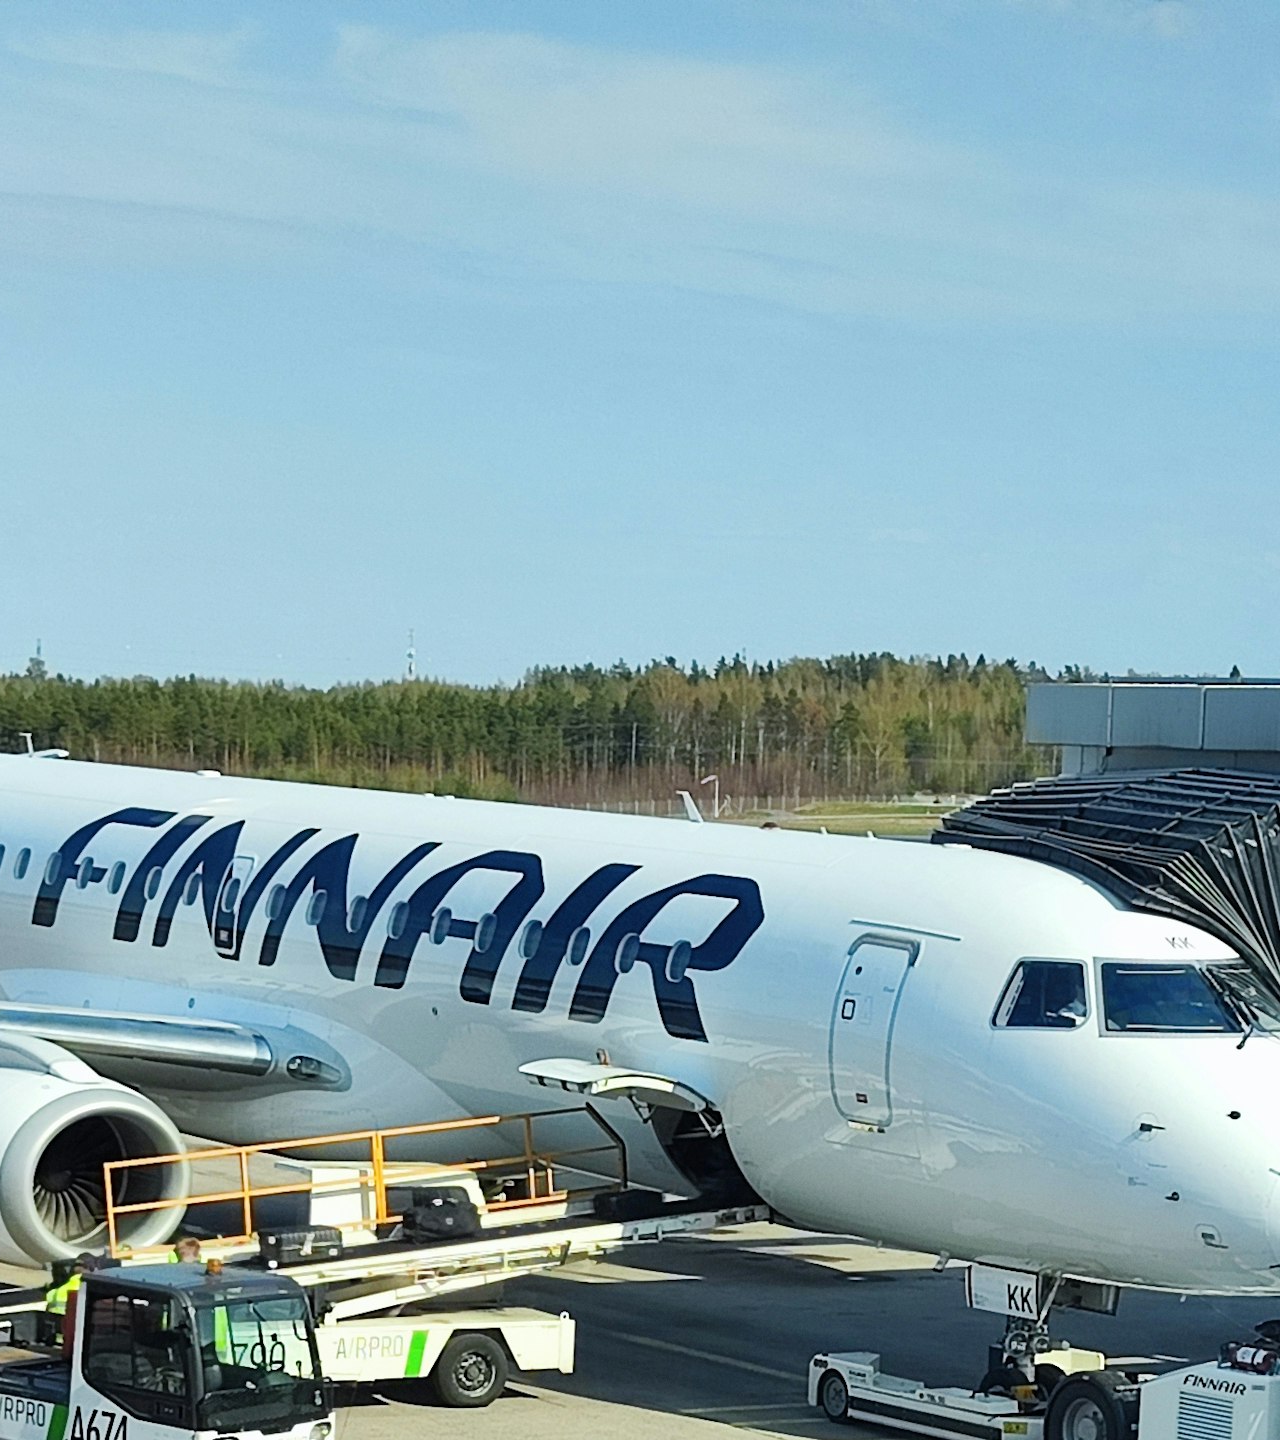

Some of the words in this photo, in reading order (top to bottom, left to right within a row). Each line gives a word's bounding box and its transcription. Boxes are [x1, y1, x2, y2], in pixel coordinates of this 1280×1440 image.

[32, 806, 765, 1042] FINNAIR
[1007, 1283, 1034, 1314] KK
[1183, 1374, 1247, 1395] FINNAIR
